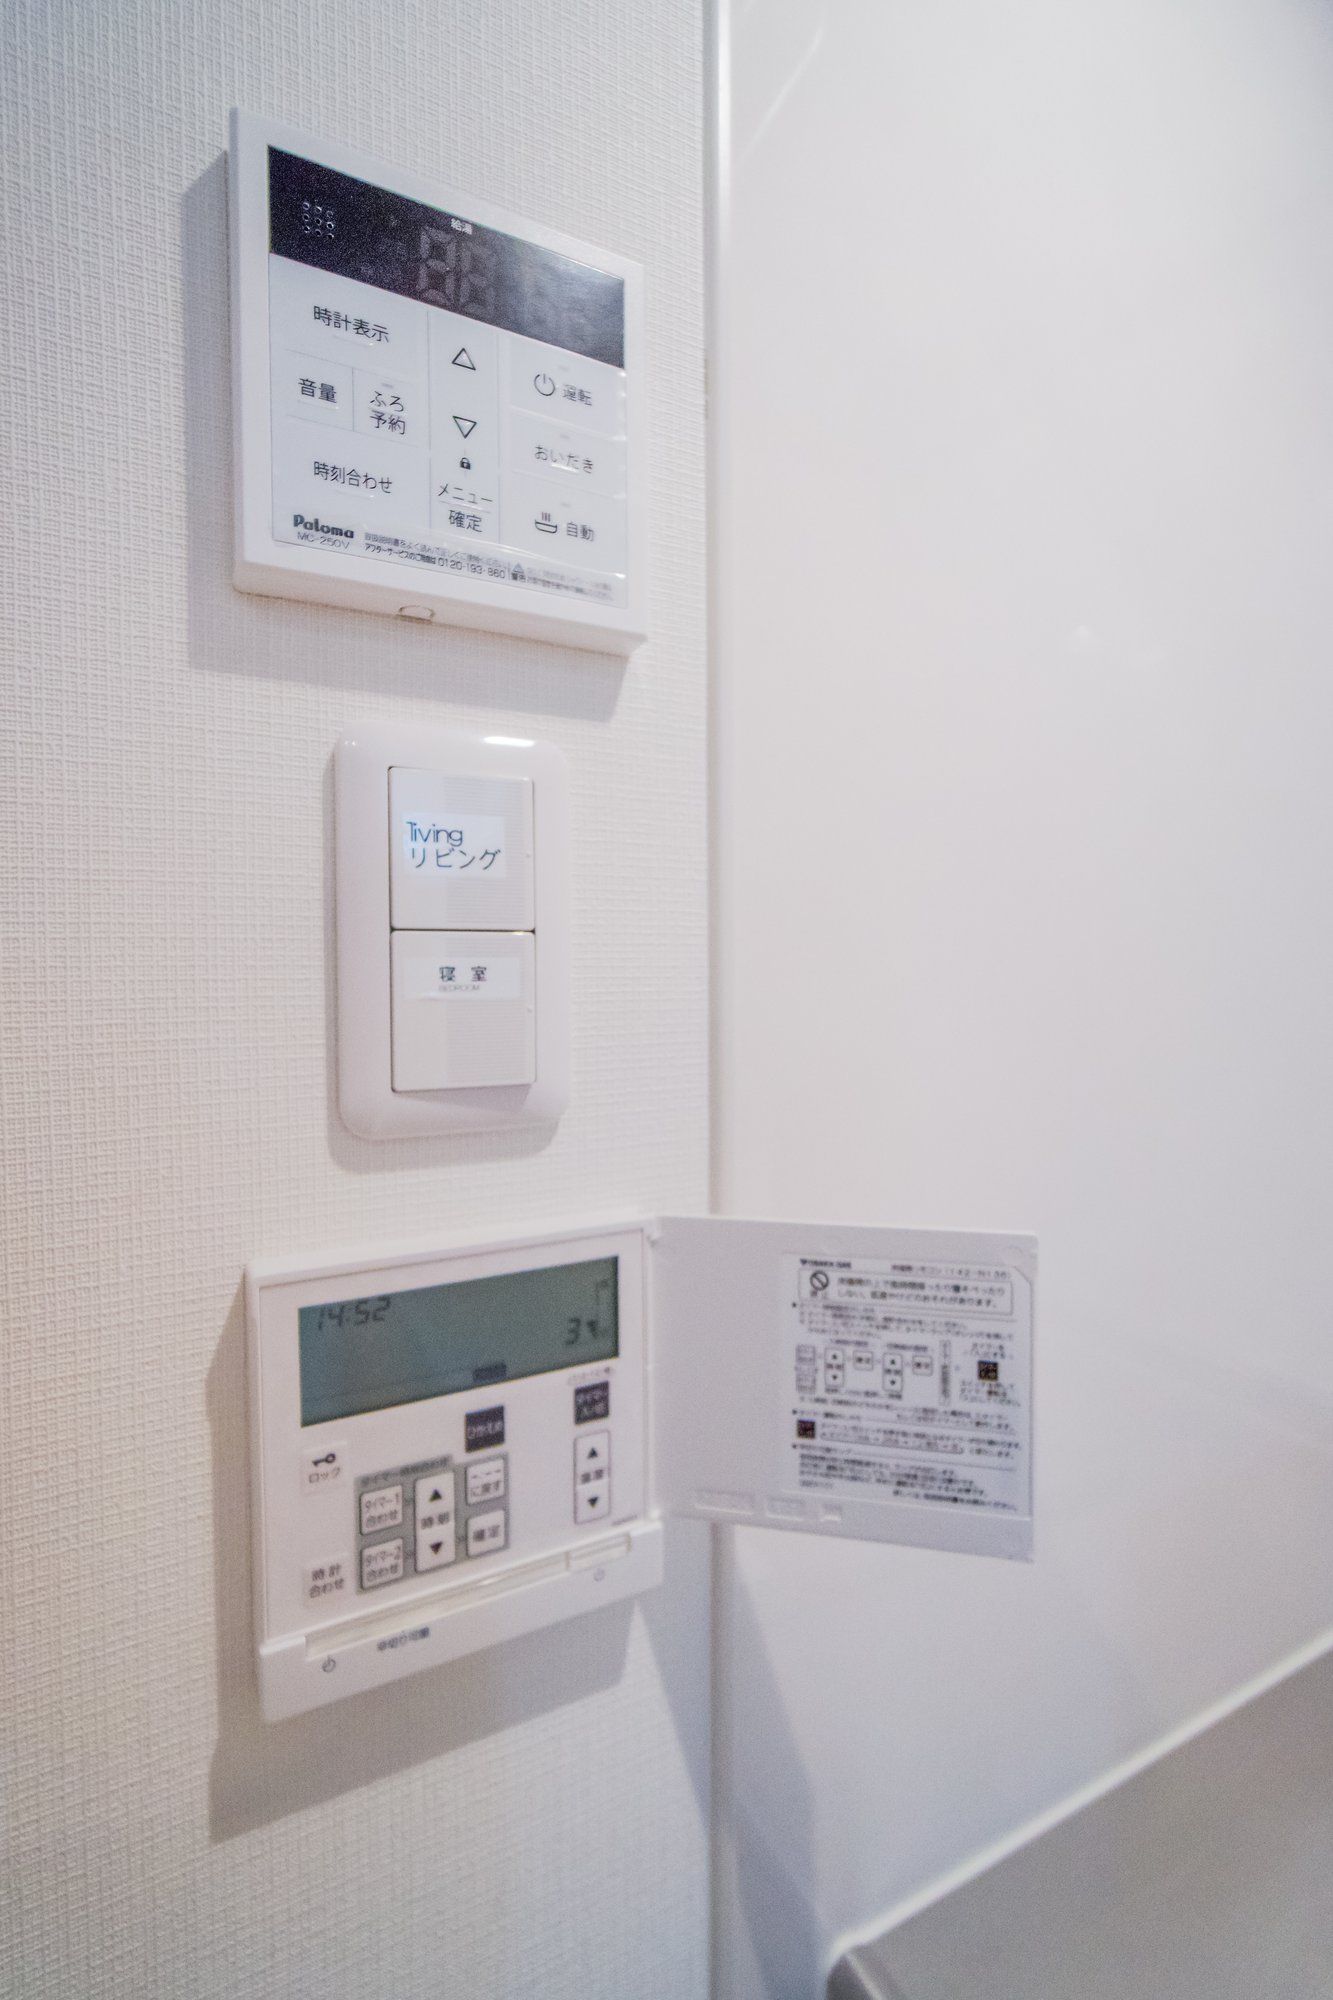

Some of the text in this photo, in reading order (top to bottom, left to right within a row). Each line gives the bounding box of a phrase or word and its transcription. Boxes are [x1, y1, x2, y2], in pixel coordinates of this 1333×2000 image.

[313, 305, 390, 343] 時計表示
[298, 378, 337, 404] 音量
[369, 390, 405, 413] ふろ
[562, 384, 593, 406] 運転
[369, 411, 406, 436] 予約
[534, 444, 595, 474] おいだき
[313, 461, 393, 494] 時刻合わせ
[437, 482, 493, 503] メニュー
[293, 513, 355, 539] Paloma
[448, 510, 483, 533] 確定
[566, 522, 595, 542] 自動
[297, 531, 349, 549] MC-250V
[411, 847, 502, 871] リビング
[308, 1466, 342, 1483] ロック
